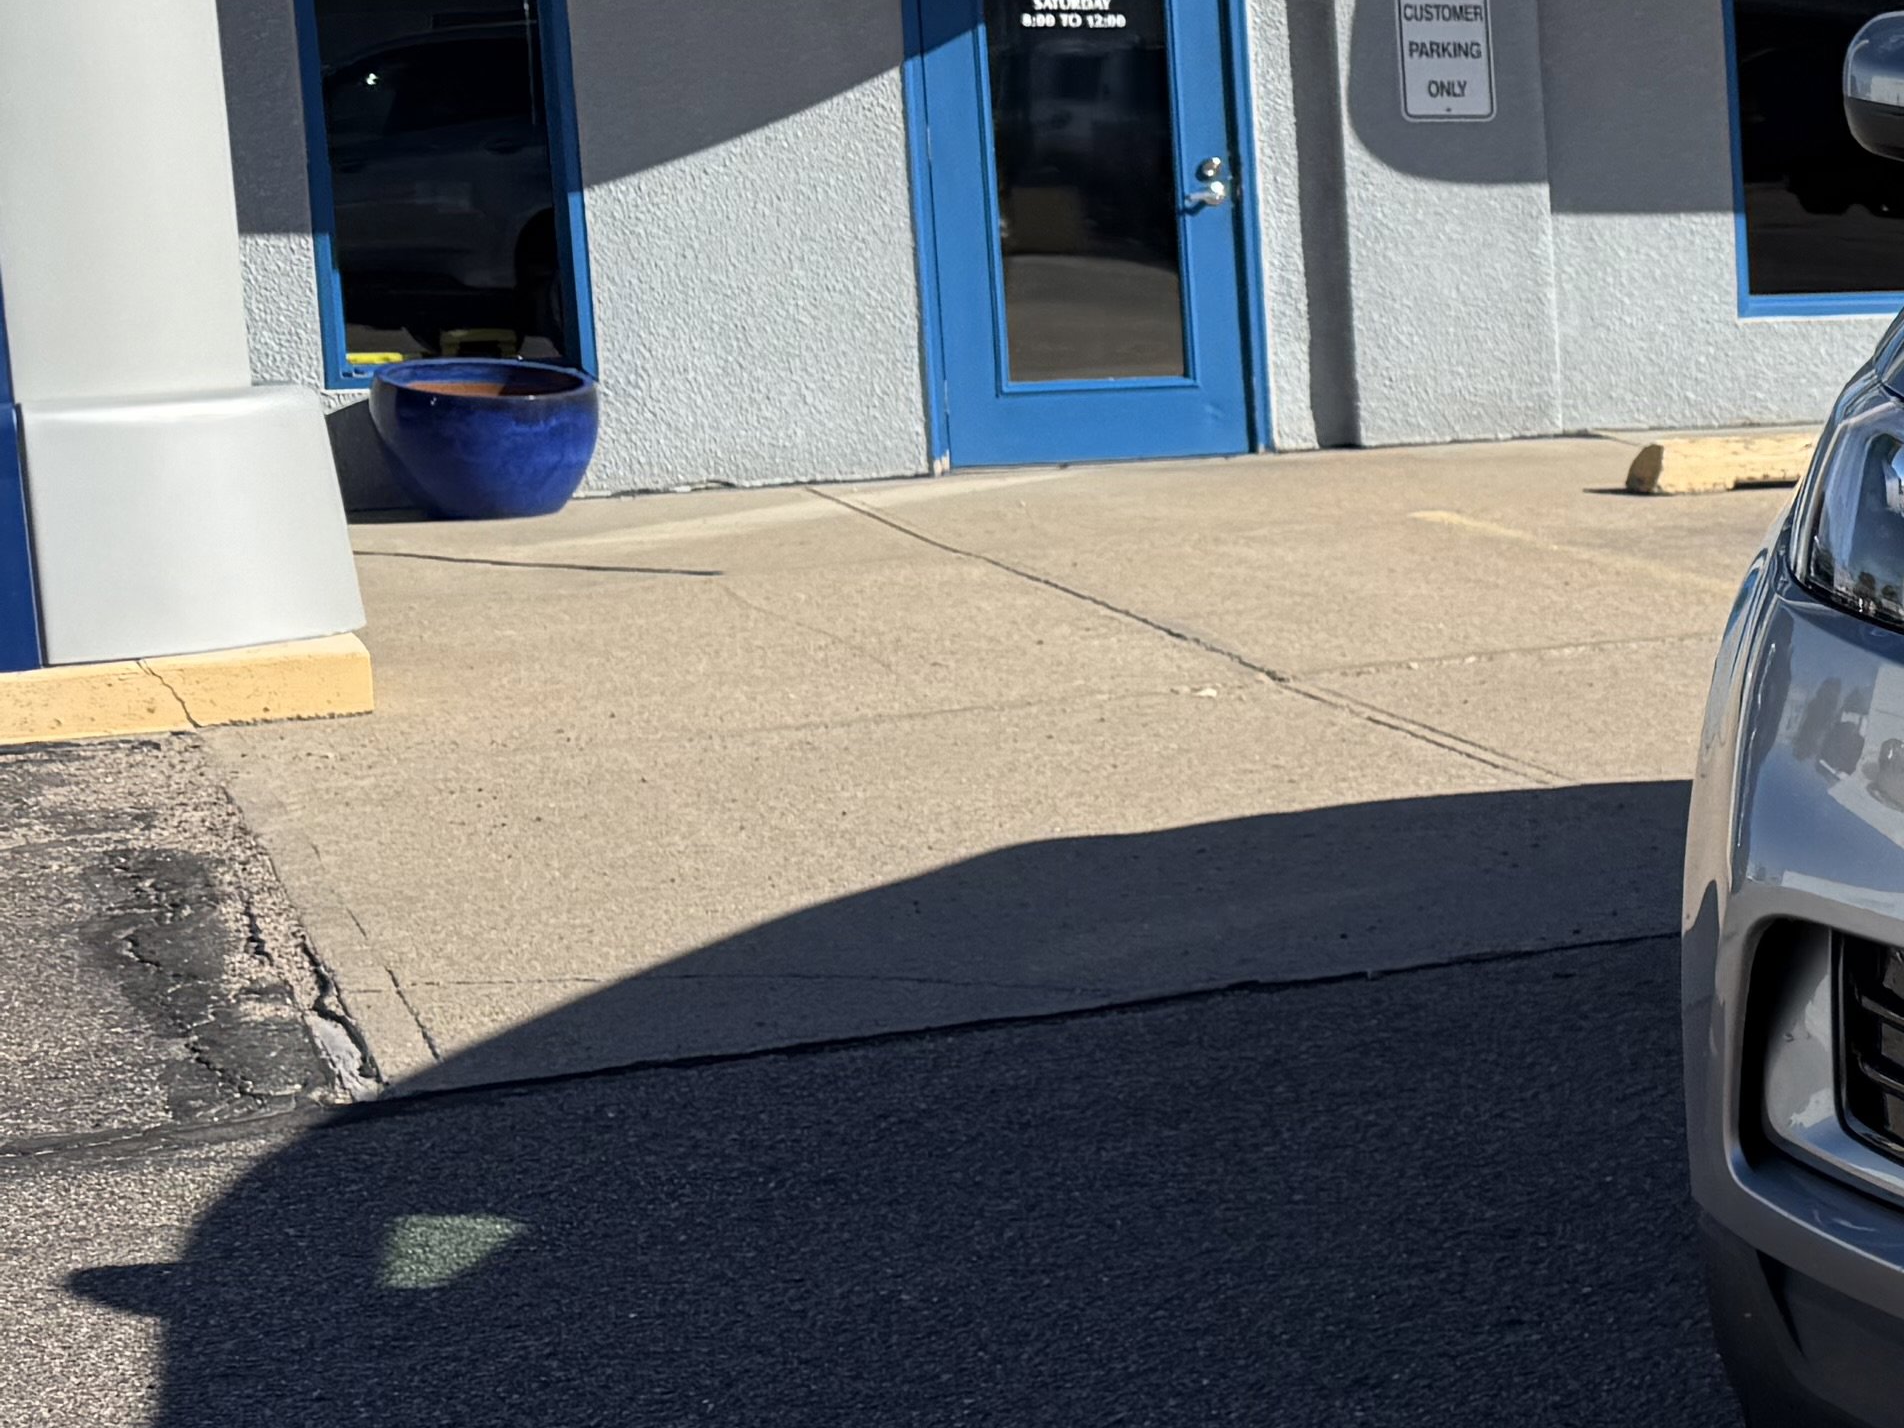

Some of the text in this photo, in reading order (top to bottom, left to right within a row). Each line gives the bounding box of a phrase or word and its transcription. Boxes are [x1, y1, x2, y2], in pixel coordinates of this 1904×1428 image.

[1021, 13, 1127, 29] 8:00 TO 12:00
[1403, 3, 1483, 22] CUSTOMER
[1408, 41, 1482, 59] PARKING
[1427, 80, 1467, 98] ONLY
